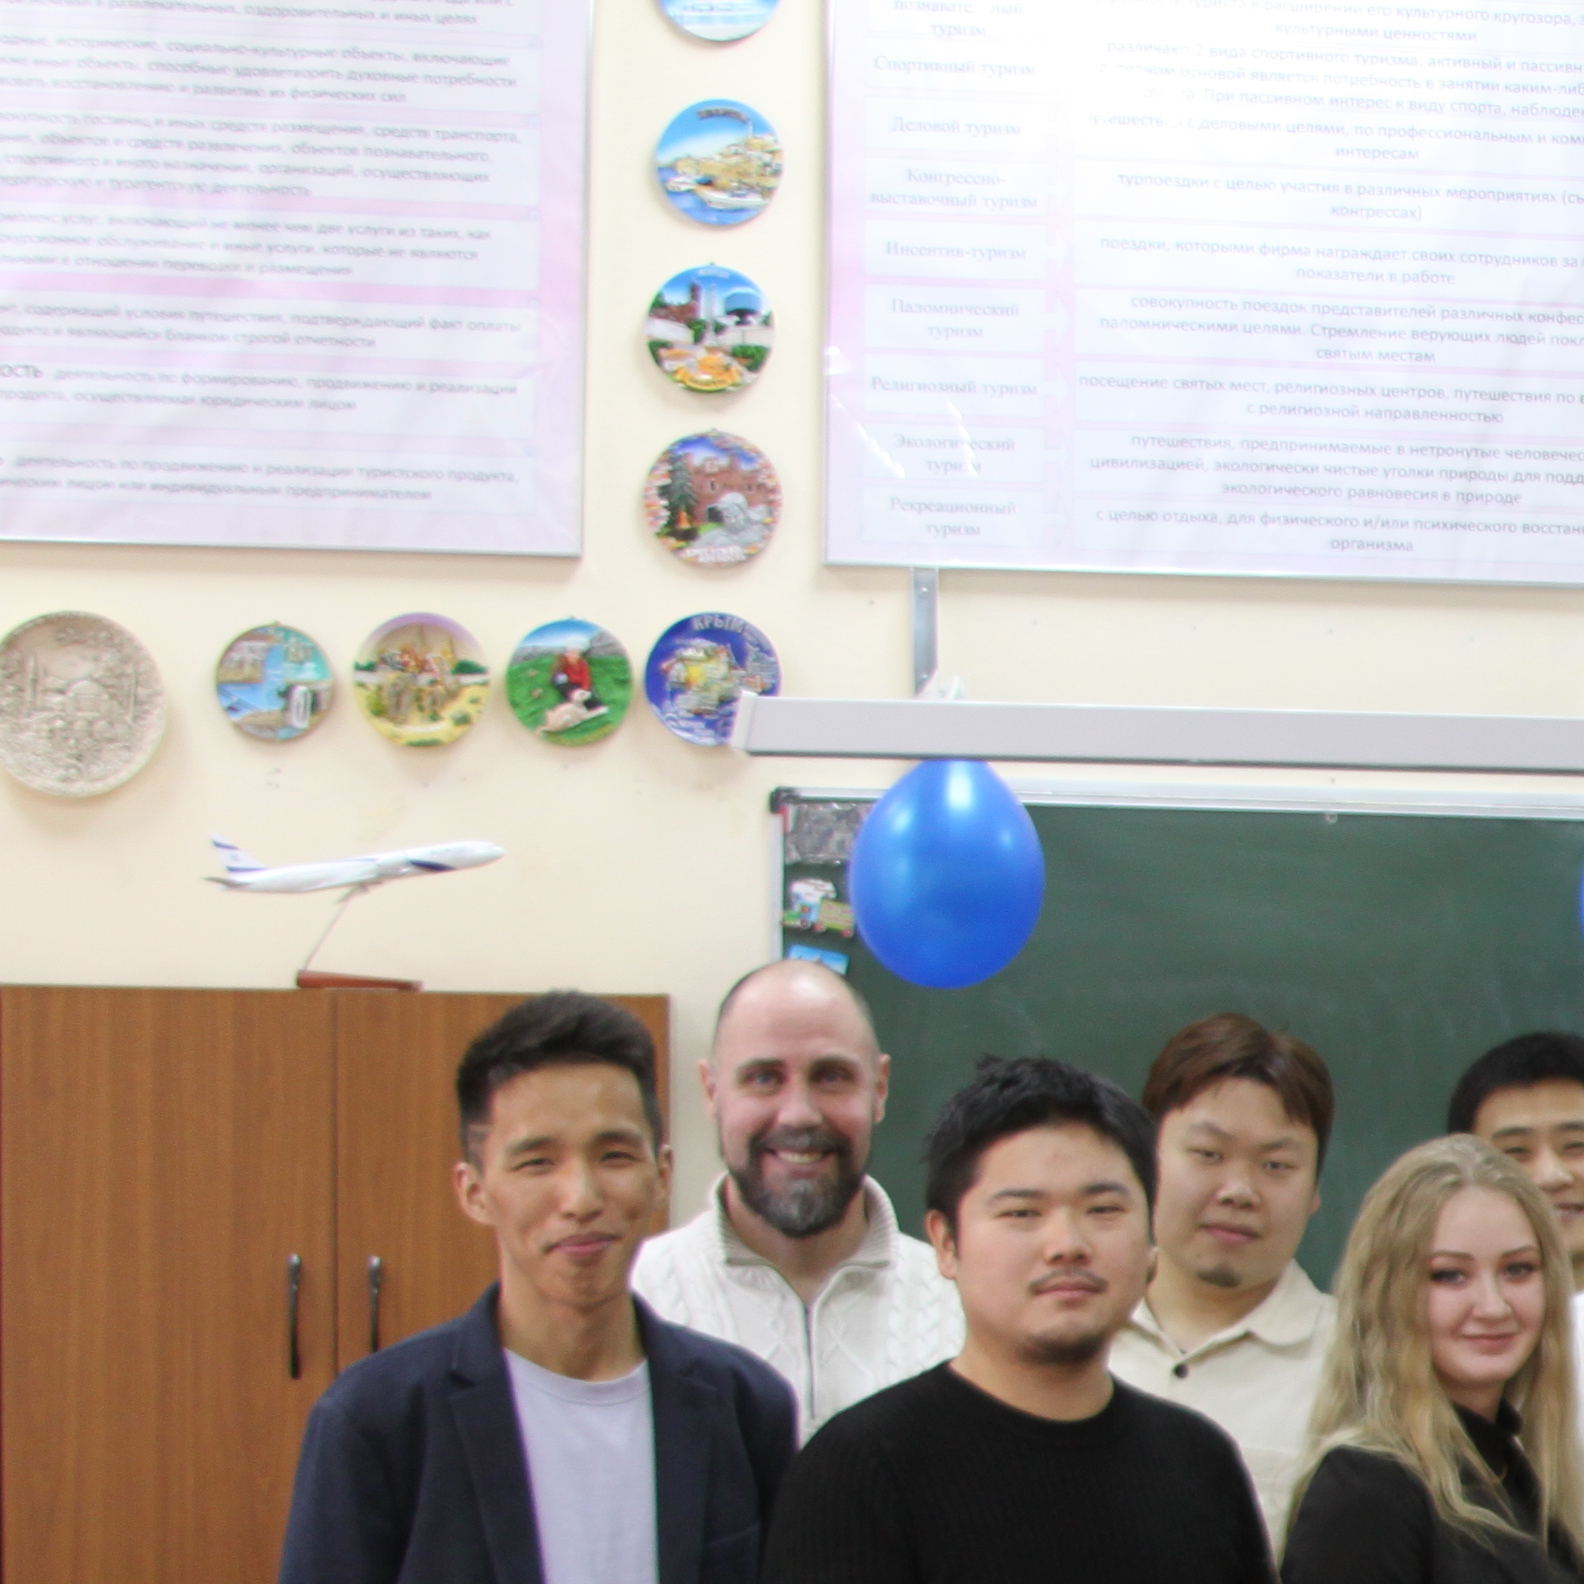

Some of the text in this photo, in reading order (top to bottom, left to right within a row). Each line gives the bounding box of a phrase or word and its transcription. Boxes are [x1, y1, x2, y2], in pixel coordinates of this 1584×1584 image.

[1275, 23, 1477, 42] культурными ценностями
[874, 56, 1036, 77] Спортивный туризм
[1209, 47, 1247, 59] вида
[1252, 49, 1349, 64] спортивного
[1354, 53, 1423, 67] туризма:
[1428, 54, 1501, 70] активный
[1181, 66, 1245, 80] основой
[1251, 70, 1318, 83] является
[1323, 73, 1421, 89] потребность
[1439, 80, 1499, 92] занятии
[1204, 88, 1235, 104] При
[1241, 92, 1323, 106] пассивном
[1329, 97, 1390, 109] интерес
[1410, 100, 1445, 113] виду
[1451, 101, 1506, 117] спорта,
[892, 117, 1020, 137] Деловой туризм
[1199, 118, 1280, 132] деловыми
[1286, 123, 1349, 136] целями,
[1354, 126, 1373, 136] по
[1379, 124, 1532, 143] профессиональным
[1335, 146, 1419, 161] интересам
[907, 168, 1006, 187] Конгрессно-
[1118, 173, 1209, 189] турпоездки
[1227, 181, 1276, 192] целью
[1280, 182, 1339, 195] участия
[1357, 184, 1441, 199] различных
[1446, 188, 1557, 204] мероприятиях
[871, 192, 1037, 210] выставочный туризм
[1331, 206, 1422, 221] конгрессах)
[887, 241, 1026, 261] Инсентив-туризм
[1100, 237, 1170, 252] поездки,
[1176, 240, 1254, 255] которыми
[1259, 243, 1310, 258] фирма
[1316, 248, 1407, 261] награждает
[1412, 252, 1454, 263] своих
[1460, 253, 1557, 268] сотрудников
[1563, 257, 1578, 268] за
[1296, 267, 1455, 284] показатели работе
[892, 299, 1019, 317] Паломнический
[1131, 295, 1237, 311] совокупность
[1243, 300, 1307, 315] поездок
[1312, 303, 1436, 319] представителей
[1440, 308, 1523, 322] различных
[928, 324, 983, 340] туризм
[1100, 317, 1237, 333] паломническими
[1243, 322, 1306, 336] целями.
[1311, 323, 1407, 339] Стремление
[1411, 329, 1490, 345] верующих
[1495, 331, 1545, 347] людей
[1316, 347, 1436, 362] святым местам
[872, 378, 1037, 398] Религиозный туризм
[1079, 375, 1168, 390] посещение
[1173, 379, 1223, 391] святых
[1230, 381, 1270, 394] мест,
[1275, 382, 1376, 397] религиозных
[1381, 386, 1448, 400] центров,
[1455, 389, 1551, 404] путешествия
[1557, 392, 1575, 404] по
[1260, 402, 1503, 423] религиозной направленностью
[1131, 435, 1235, 450] путешествия,
[1241, 440, 1392, 455] предпринимаемые
[1410, 446, 1500, 460] нетронутые
[1090, 457, 1208, 472] цивилизацией,
[1214, 461, 1318, 474] экологически
[1324, 465, 1378, 476] чистые
[1383, 466, 1434, 480] уголки
[1440, 468, 1507, 483] природы
[1513, 472, 1541, 484] для
[1221, 483, 1521, 505] экологического равновесия природе
[890, 496, 1016, 516] Рекреационный
[927, 522, 980, 537] туризм
[1109, 510, 1158, 523] целью
[1164, 511, 1222, 526] отдыха,
[1227, 515, 1255, 526] для
[1261, 513, 1358, 529] физического
[1363, 514, 1409, 531] и/или
[1414, 519, 1517, 534] психического
[1330, 537, 1413, 552] организма
